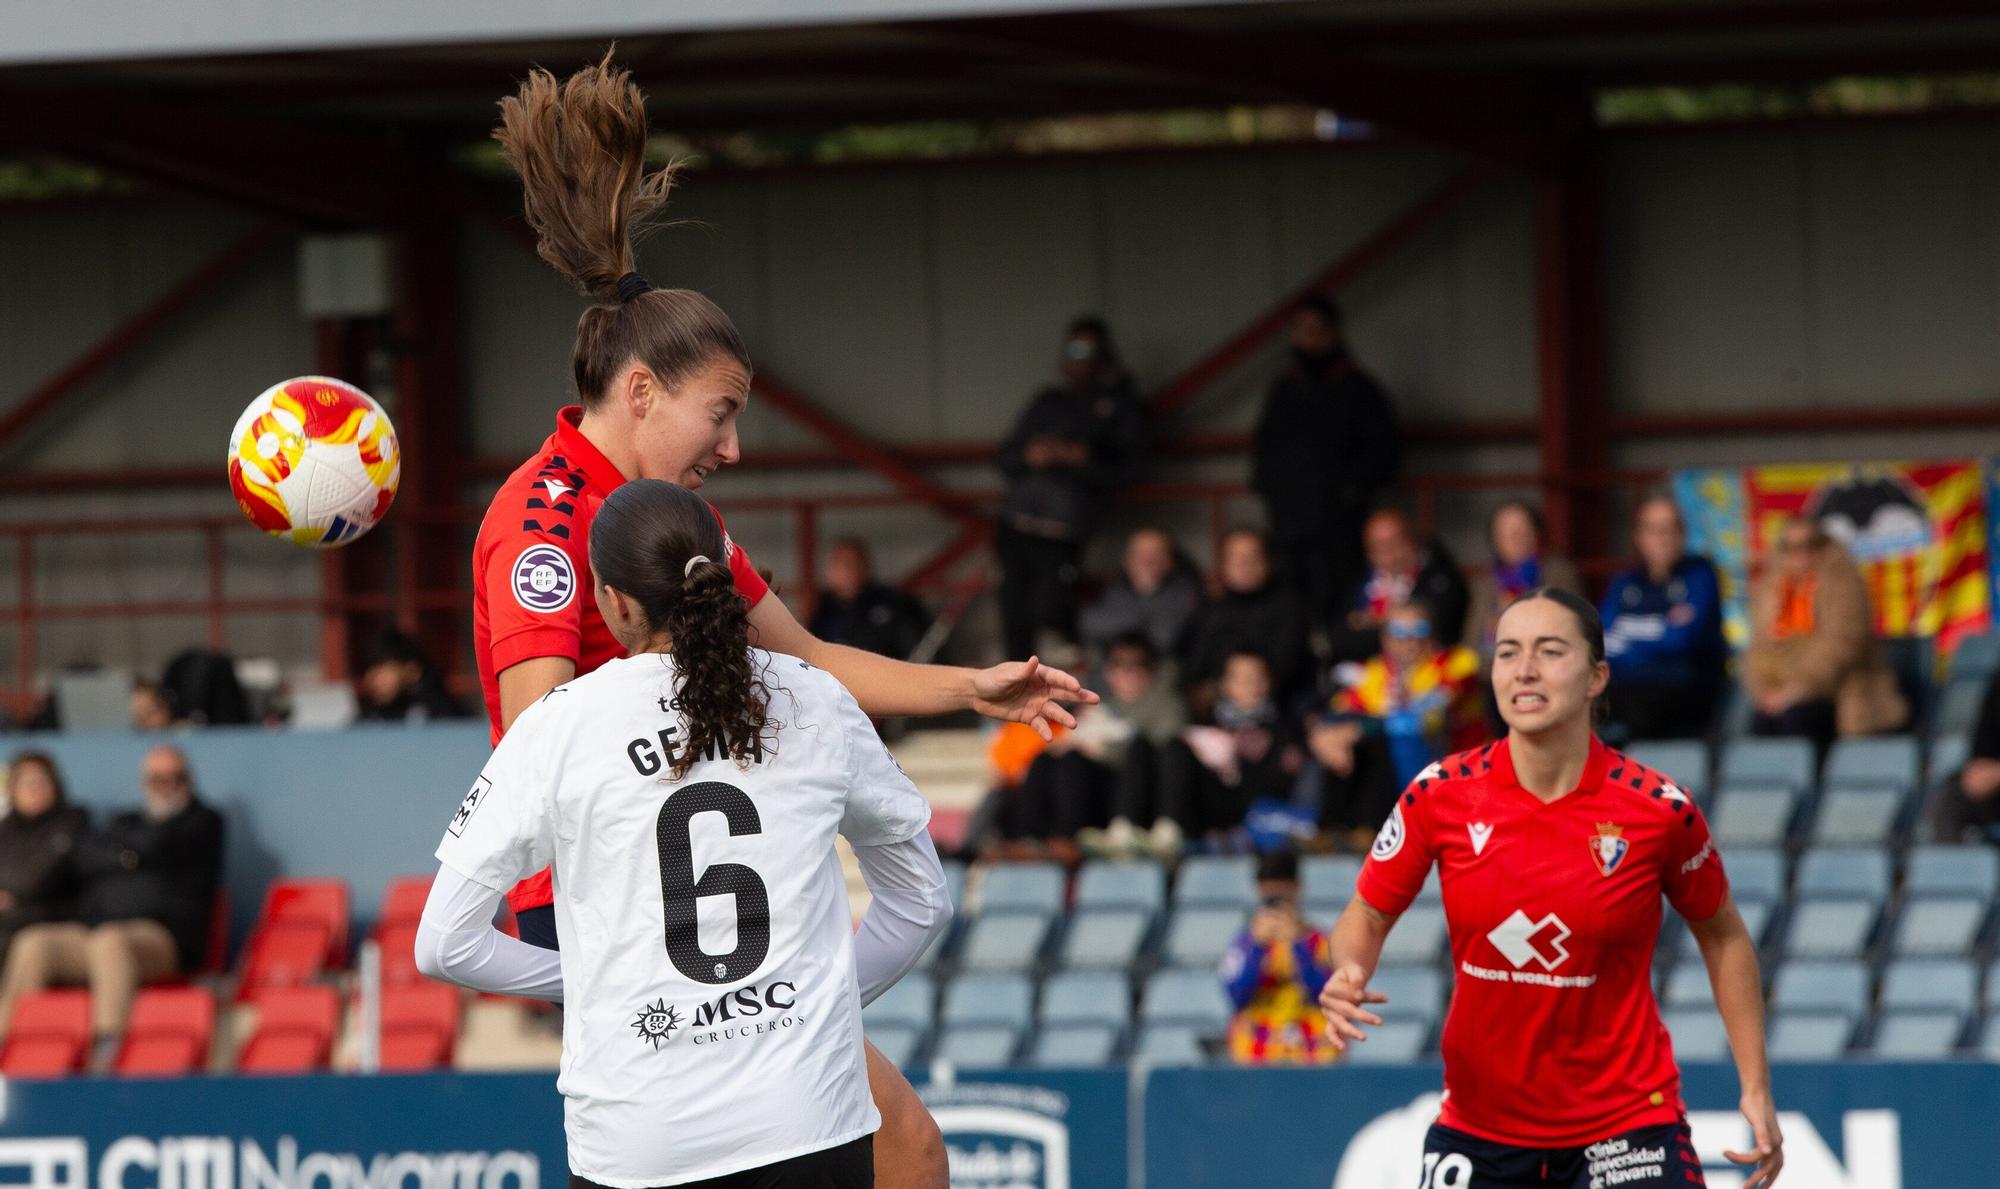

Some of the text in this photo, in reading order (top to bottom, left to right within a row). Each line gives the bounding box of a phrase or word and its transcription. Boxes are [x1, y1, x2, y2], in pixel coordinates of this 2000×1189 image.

[627, 723, 764, 777] GEMA
[656, 781, 770, 985] 6
[692, 981, 796, 1026] MSC
[693, 1015, 805, 1045] CRUCEROS
[1605, 1164, 1662, 1187] Navarra
